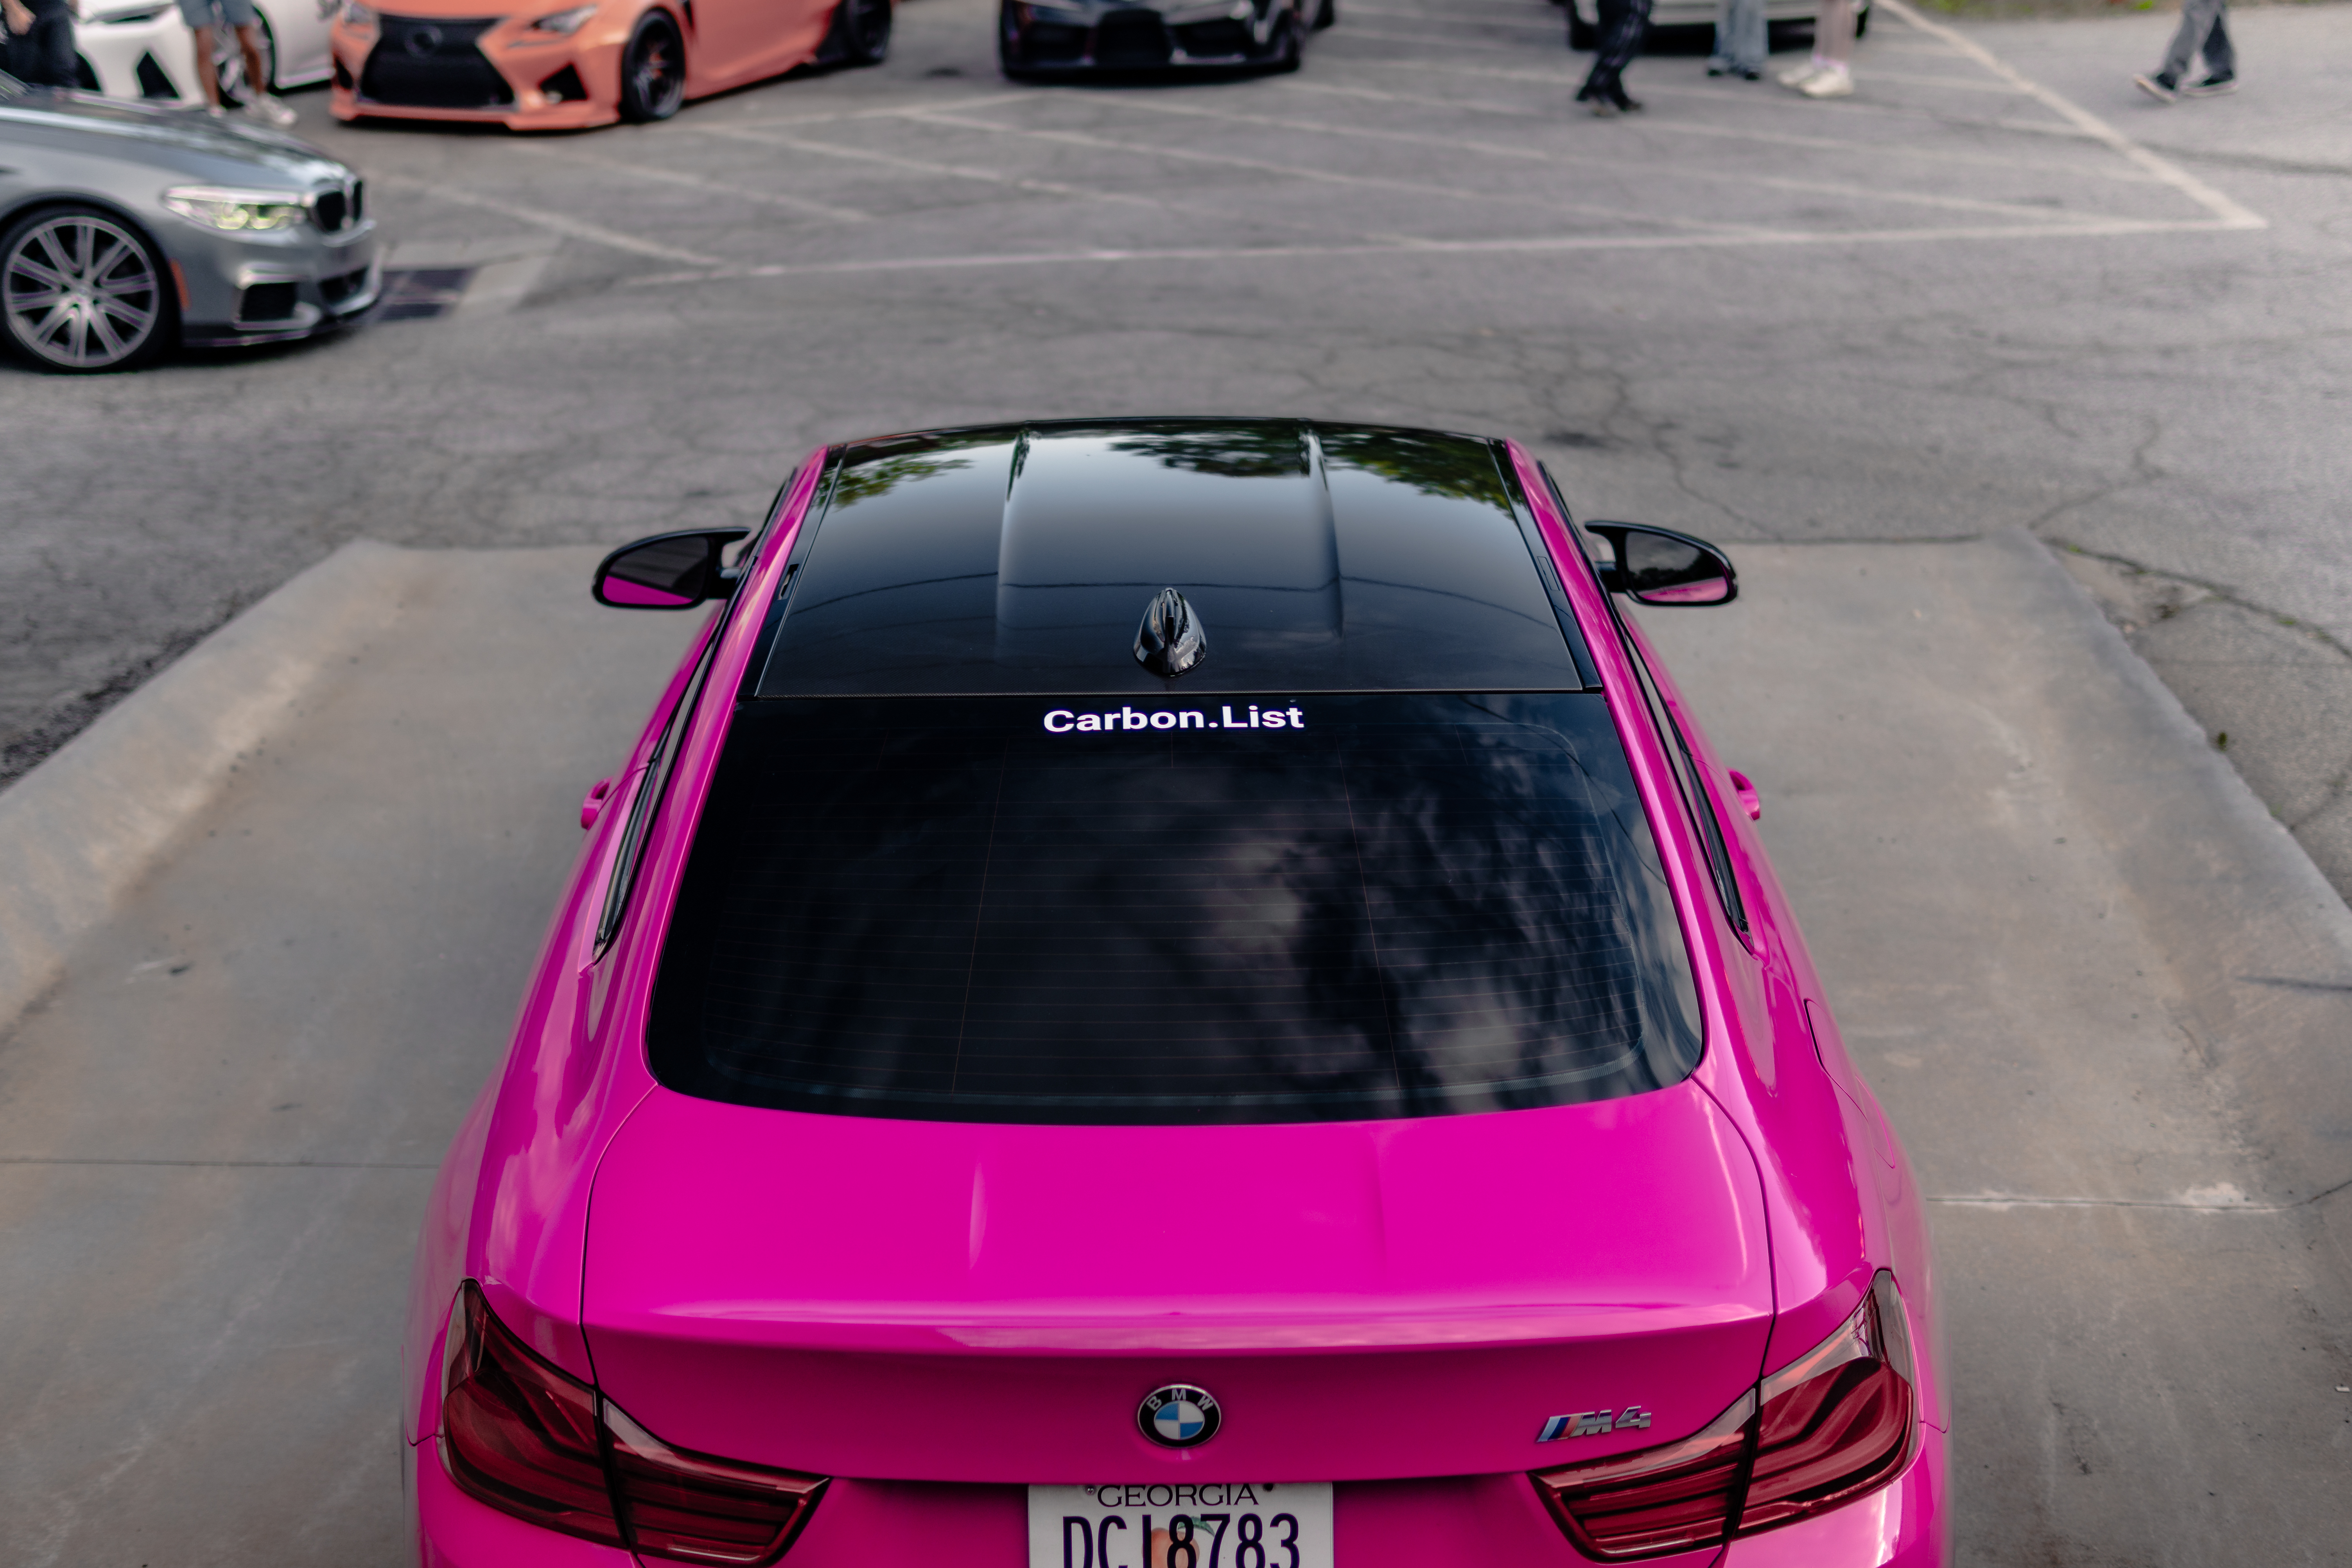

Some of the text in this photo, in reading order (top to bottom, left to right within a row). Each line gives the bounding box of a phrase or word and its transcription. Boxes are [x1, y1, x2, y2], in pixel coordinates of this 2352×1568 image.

[1043, 705, 1305, 732] Carbon.List
[1146, 1388, 1213, 1411] BMW
[1568, 1405, 1652, 1438] M4
[1097, 1484, 1260, 1508] GEORGIA
